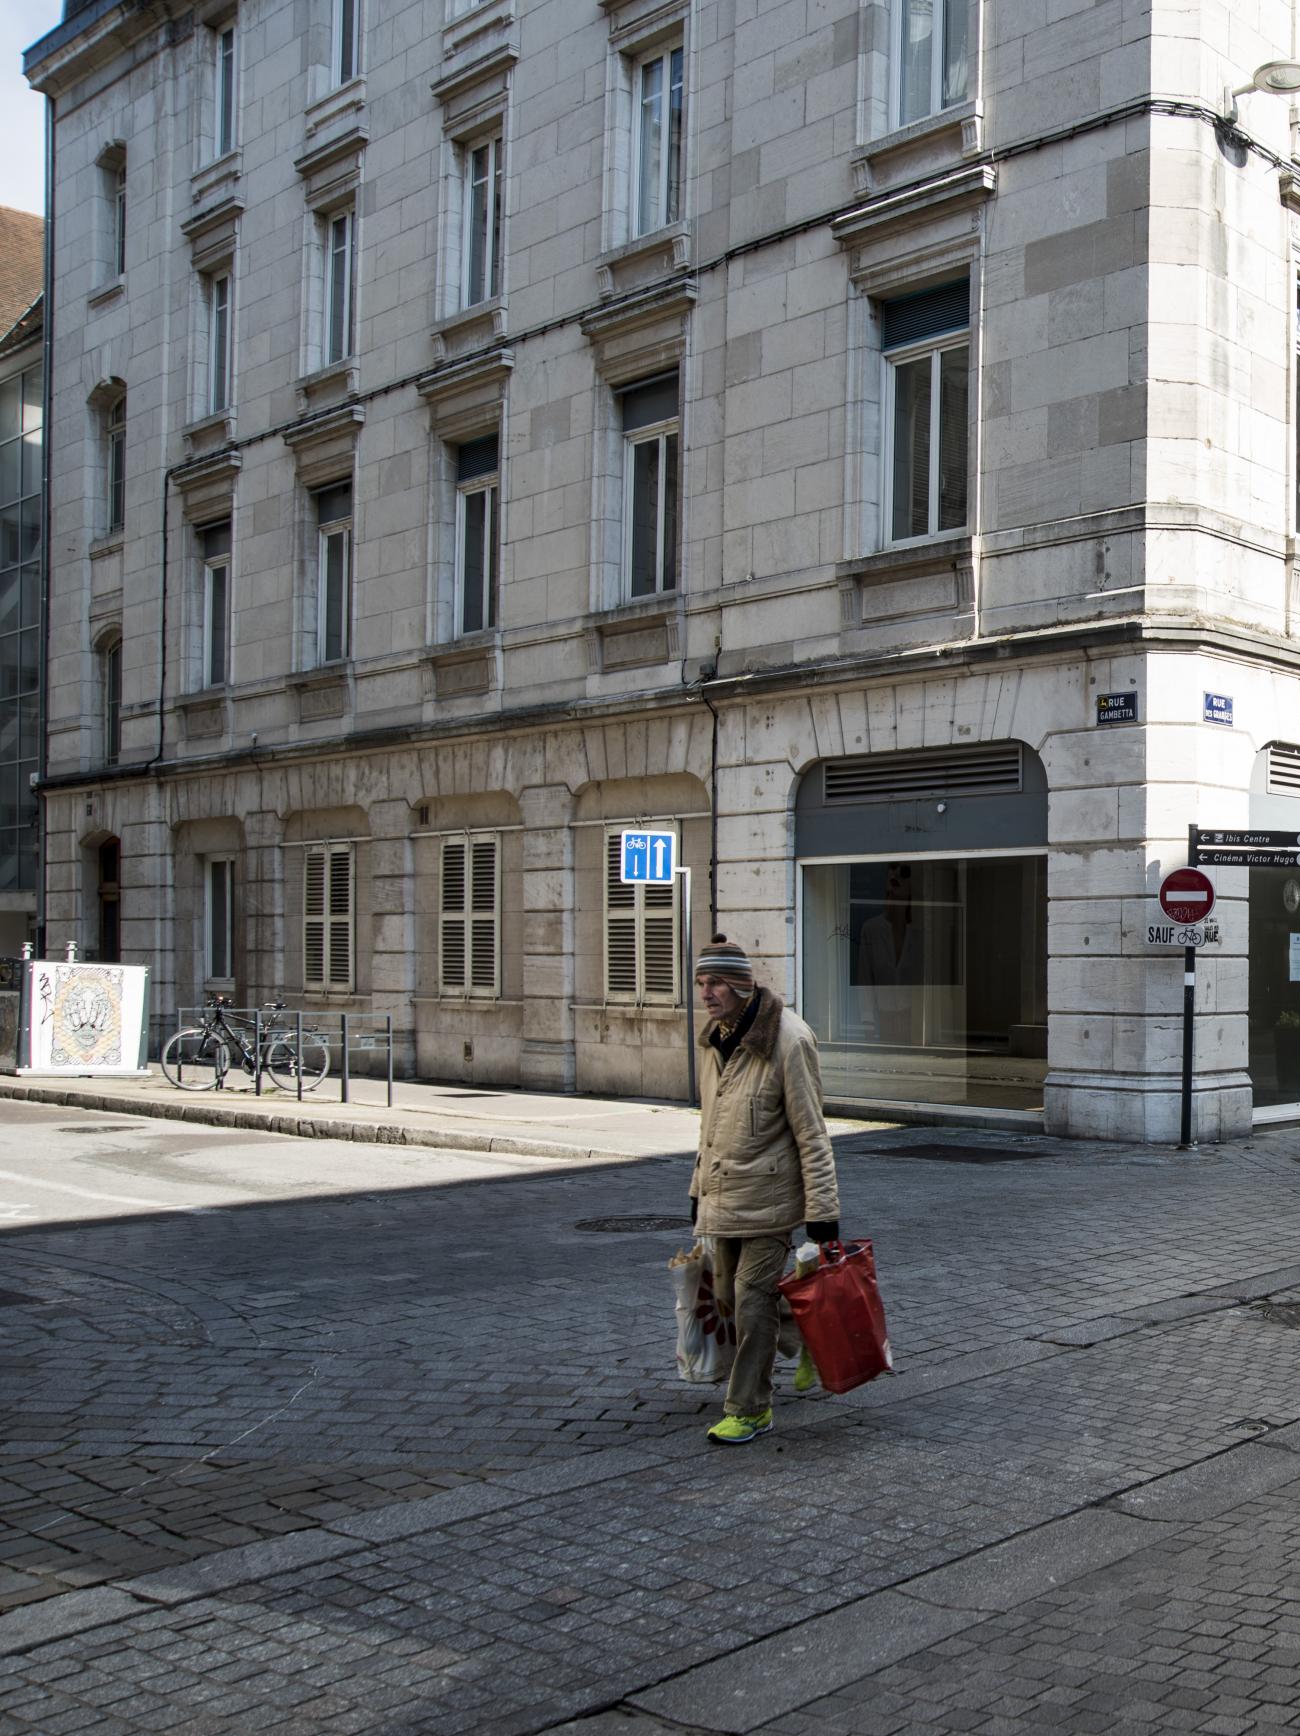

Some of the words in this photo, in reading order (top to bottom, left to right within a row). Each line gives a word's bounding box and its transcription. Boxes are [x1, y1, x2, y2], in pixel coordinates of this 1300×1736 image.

[1108, 697, 1125, 707] RUE
[1213, 697, 1225, 708] RUE
[1100, 709, 1133, 720] GAMBETTA
[1226, 834, 1240, 843] Ibis
[1243, 834, 1270, 843] Centre
[1213, 853, 1243, 862] Cinéma
[1247, 854, 1271, 863] Victor
[1273, 854, 1295, 865] Hugo
[1148, 926, 1175, 943] SAUF
